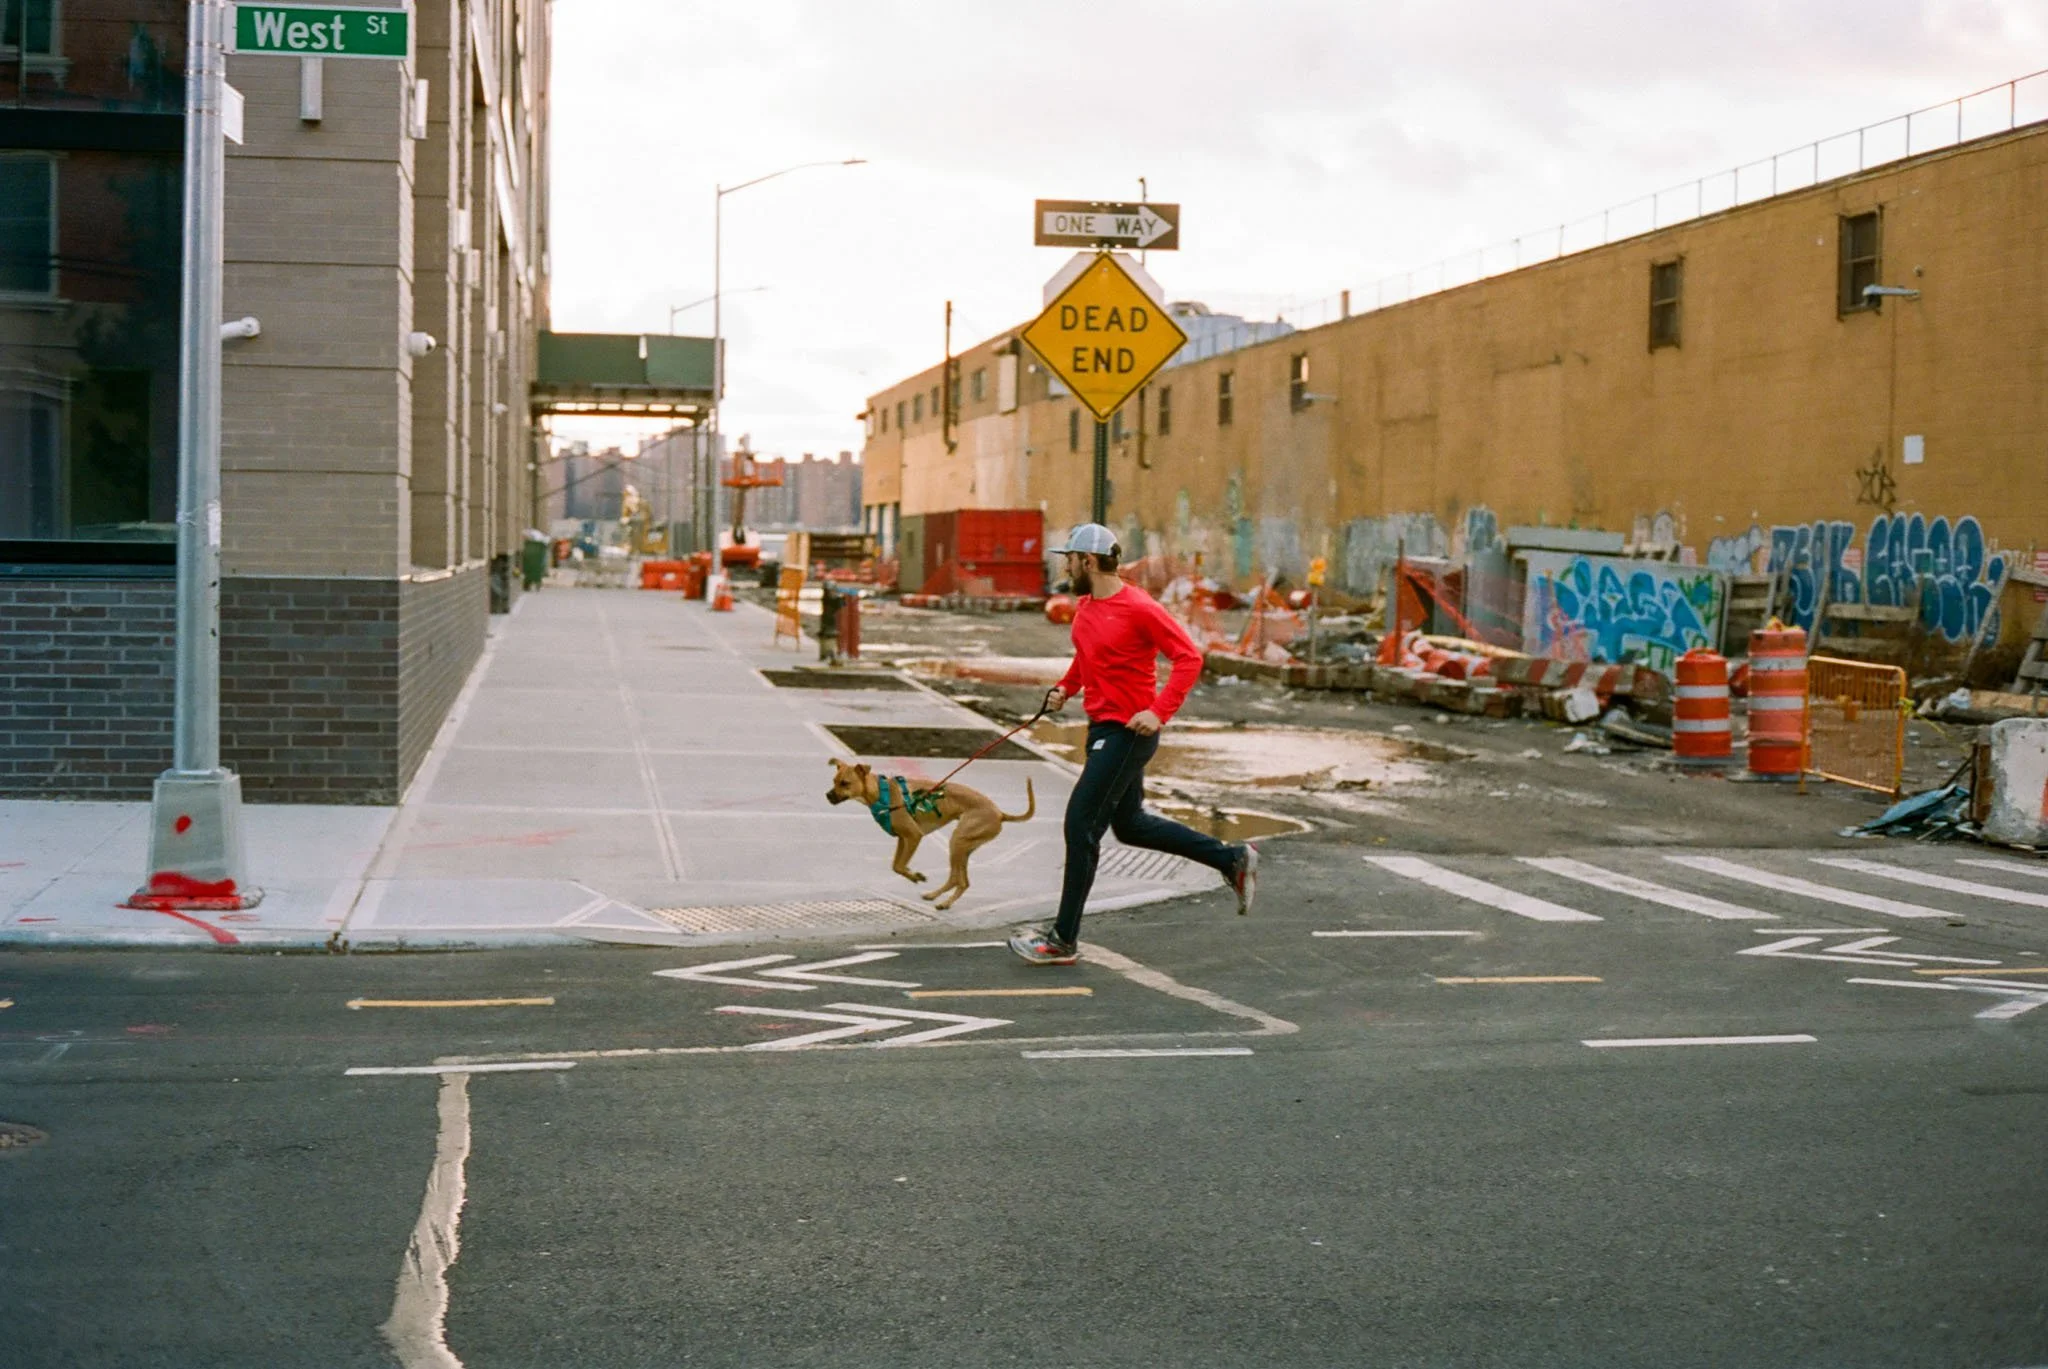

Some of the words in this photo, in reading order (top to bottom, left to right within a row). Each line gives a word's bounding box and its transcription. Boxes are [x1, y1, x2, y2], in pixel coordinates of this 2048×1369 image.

[253, 11, 346, 50] West
[366, 15, 388, 35] St
[1055, 215, 1096, 234] ONE
[1115, 217, 1158, 236] WAY
[1061, 305, 1148, 332] DEAD
[1073, 347, 1135, 374] END
